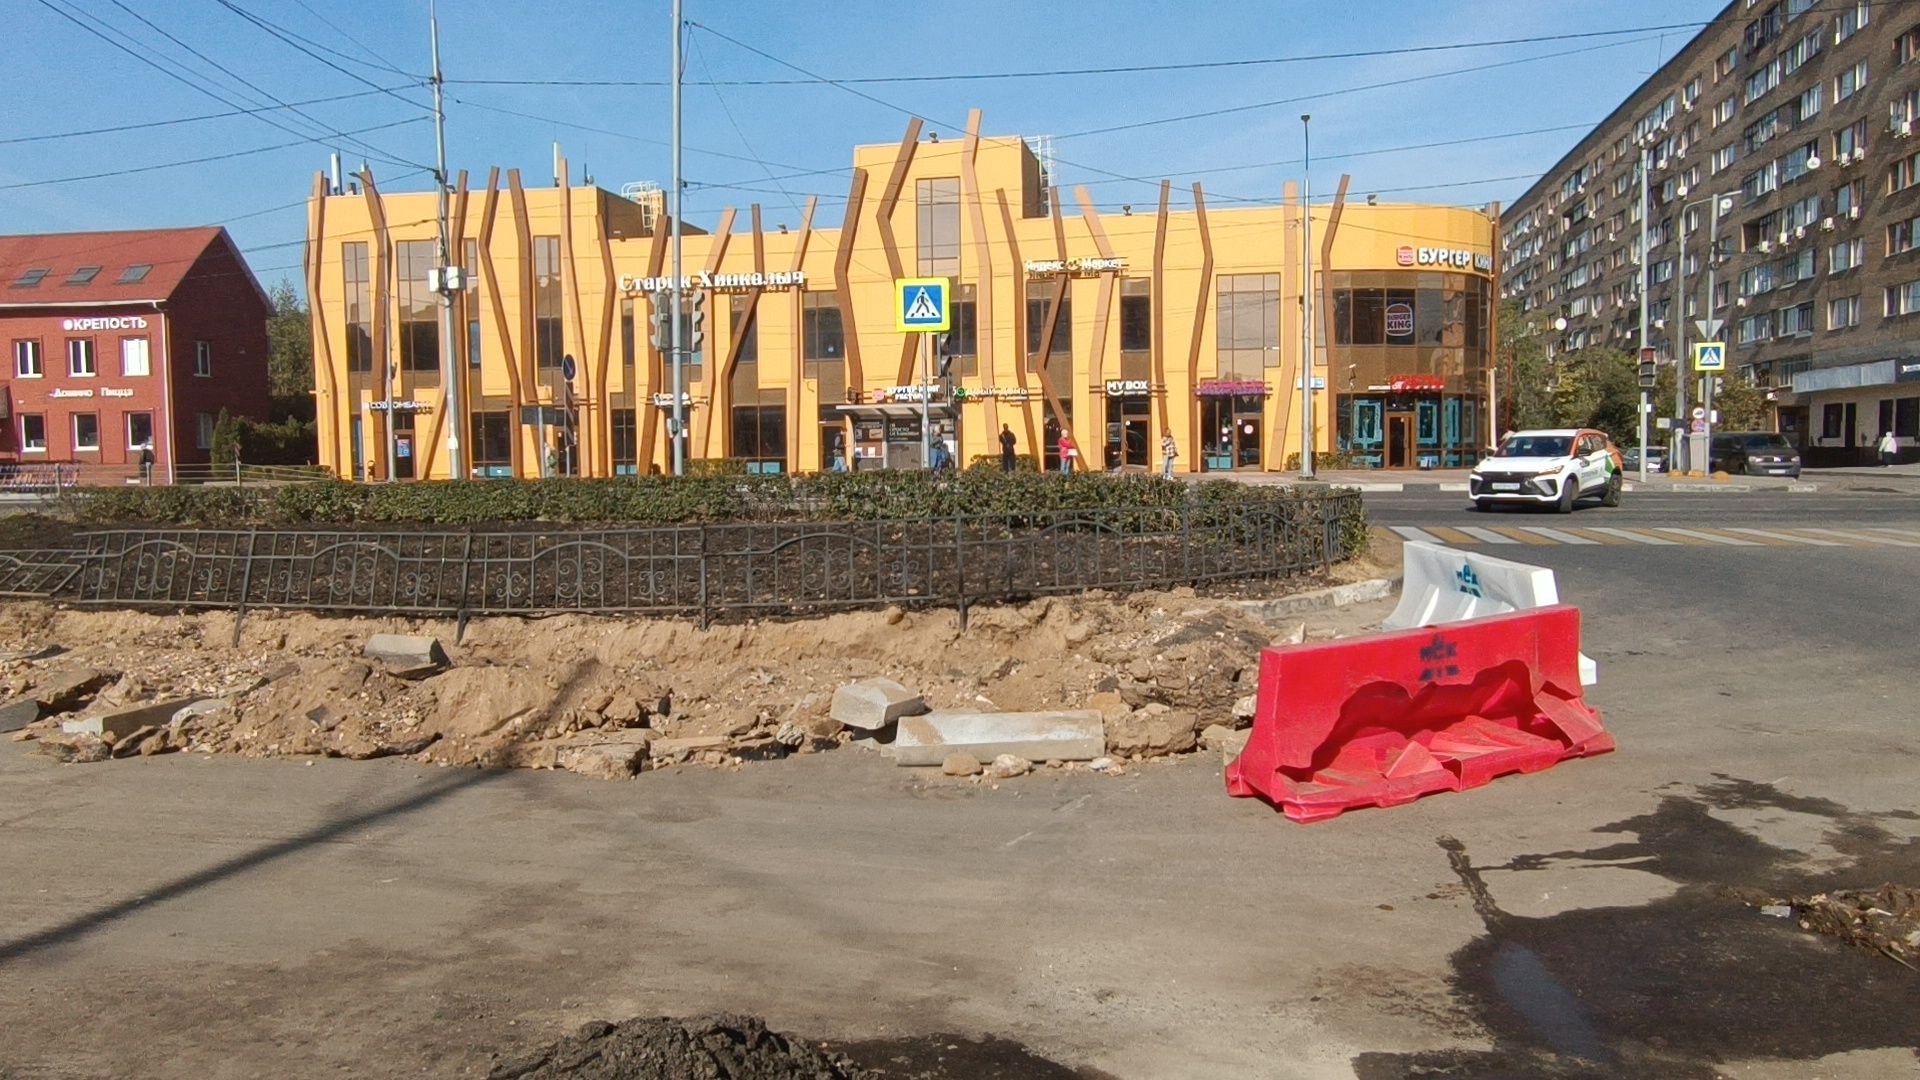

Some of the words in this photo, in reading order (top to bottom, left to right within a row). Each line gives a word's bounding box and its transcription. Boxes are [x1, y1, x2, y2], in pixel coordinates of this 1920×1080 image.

[1026, 260, 1065, 272] Яндекс
[1083, 257, 1122, 270] Маркет
[1417, 247, 1471, 266] БУРГЕР
[1474, 253, 1492, 270] КИН
[618, 272, 692, 292] Старк
[698, 270, 804, 288] Хинкалыч
[73, 316, 148, 331] КРЕПОСТЬ
[1387, 320, 1412, 330] KING
[1125, 380, 1148, 390] BOX
